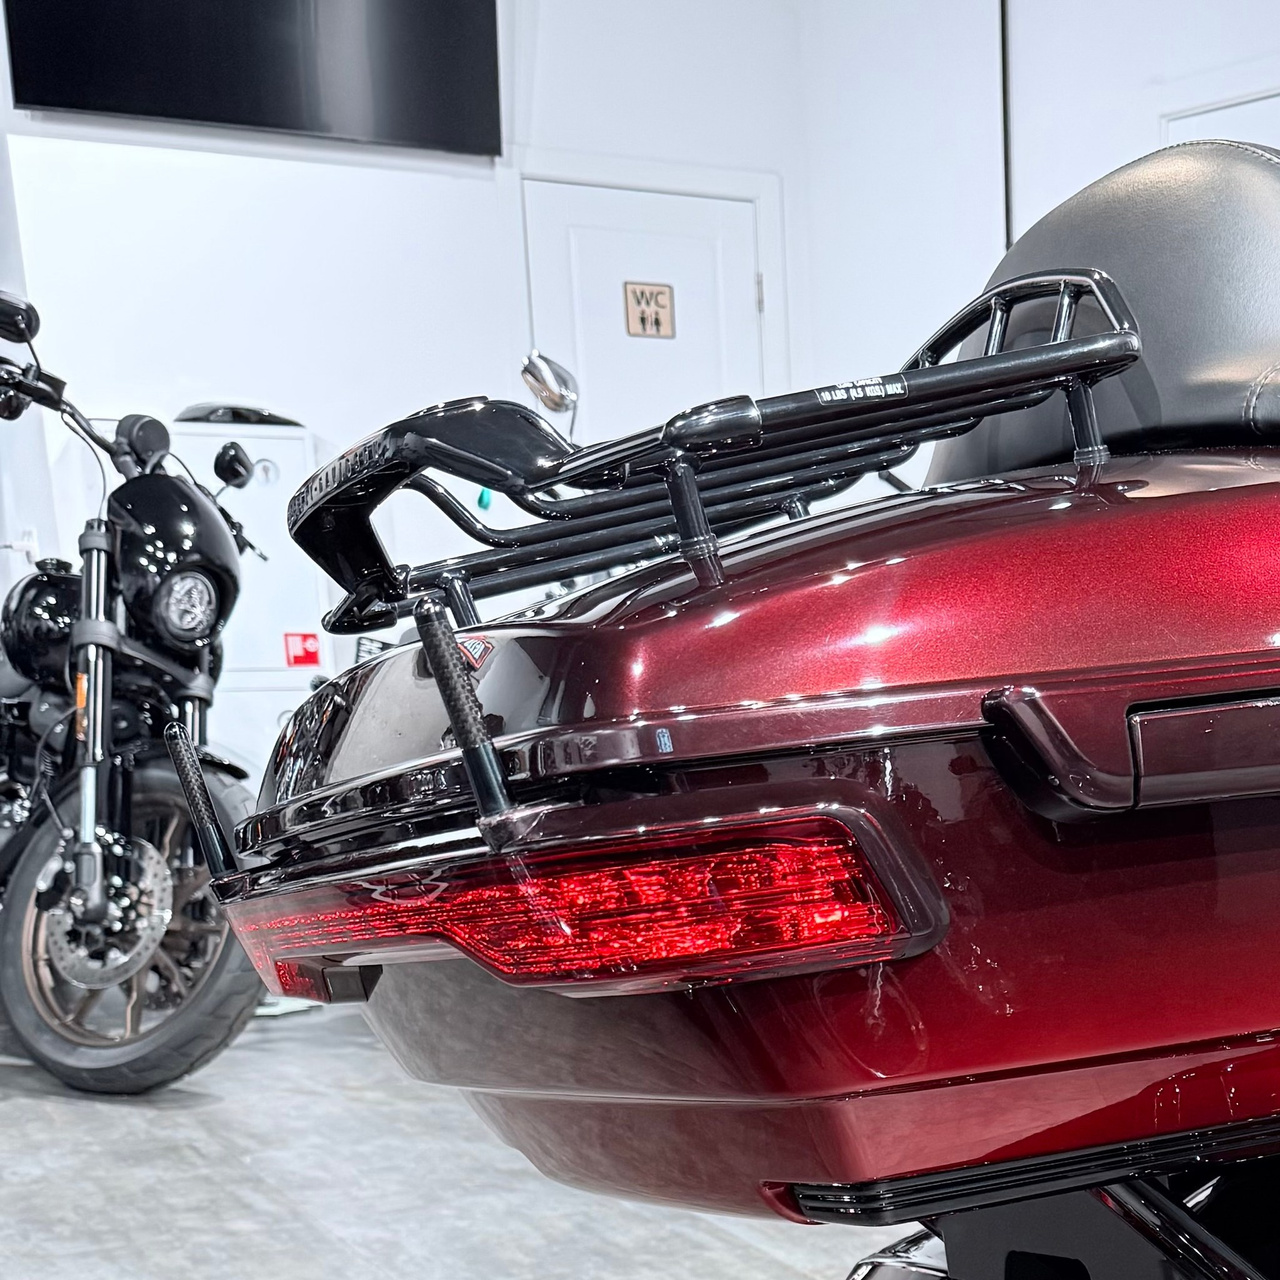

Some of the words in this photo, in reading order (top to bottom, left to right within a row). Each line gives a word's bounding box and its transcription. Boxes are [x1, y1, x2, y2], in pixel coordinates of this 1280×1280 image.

[631, 287, 668, 309] WC
[821, 391, 832, 402] 10
[831, 389, 848, 401] LBS
